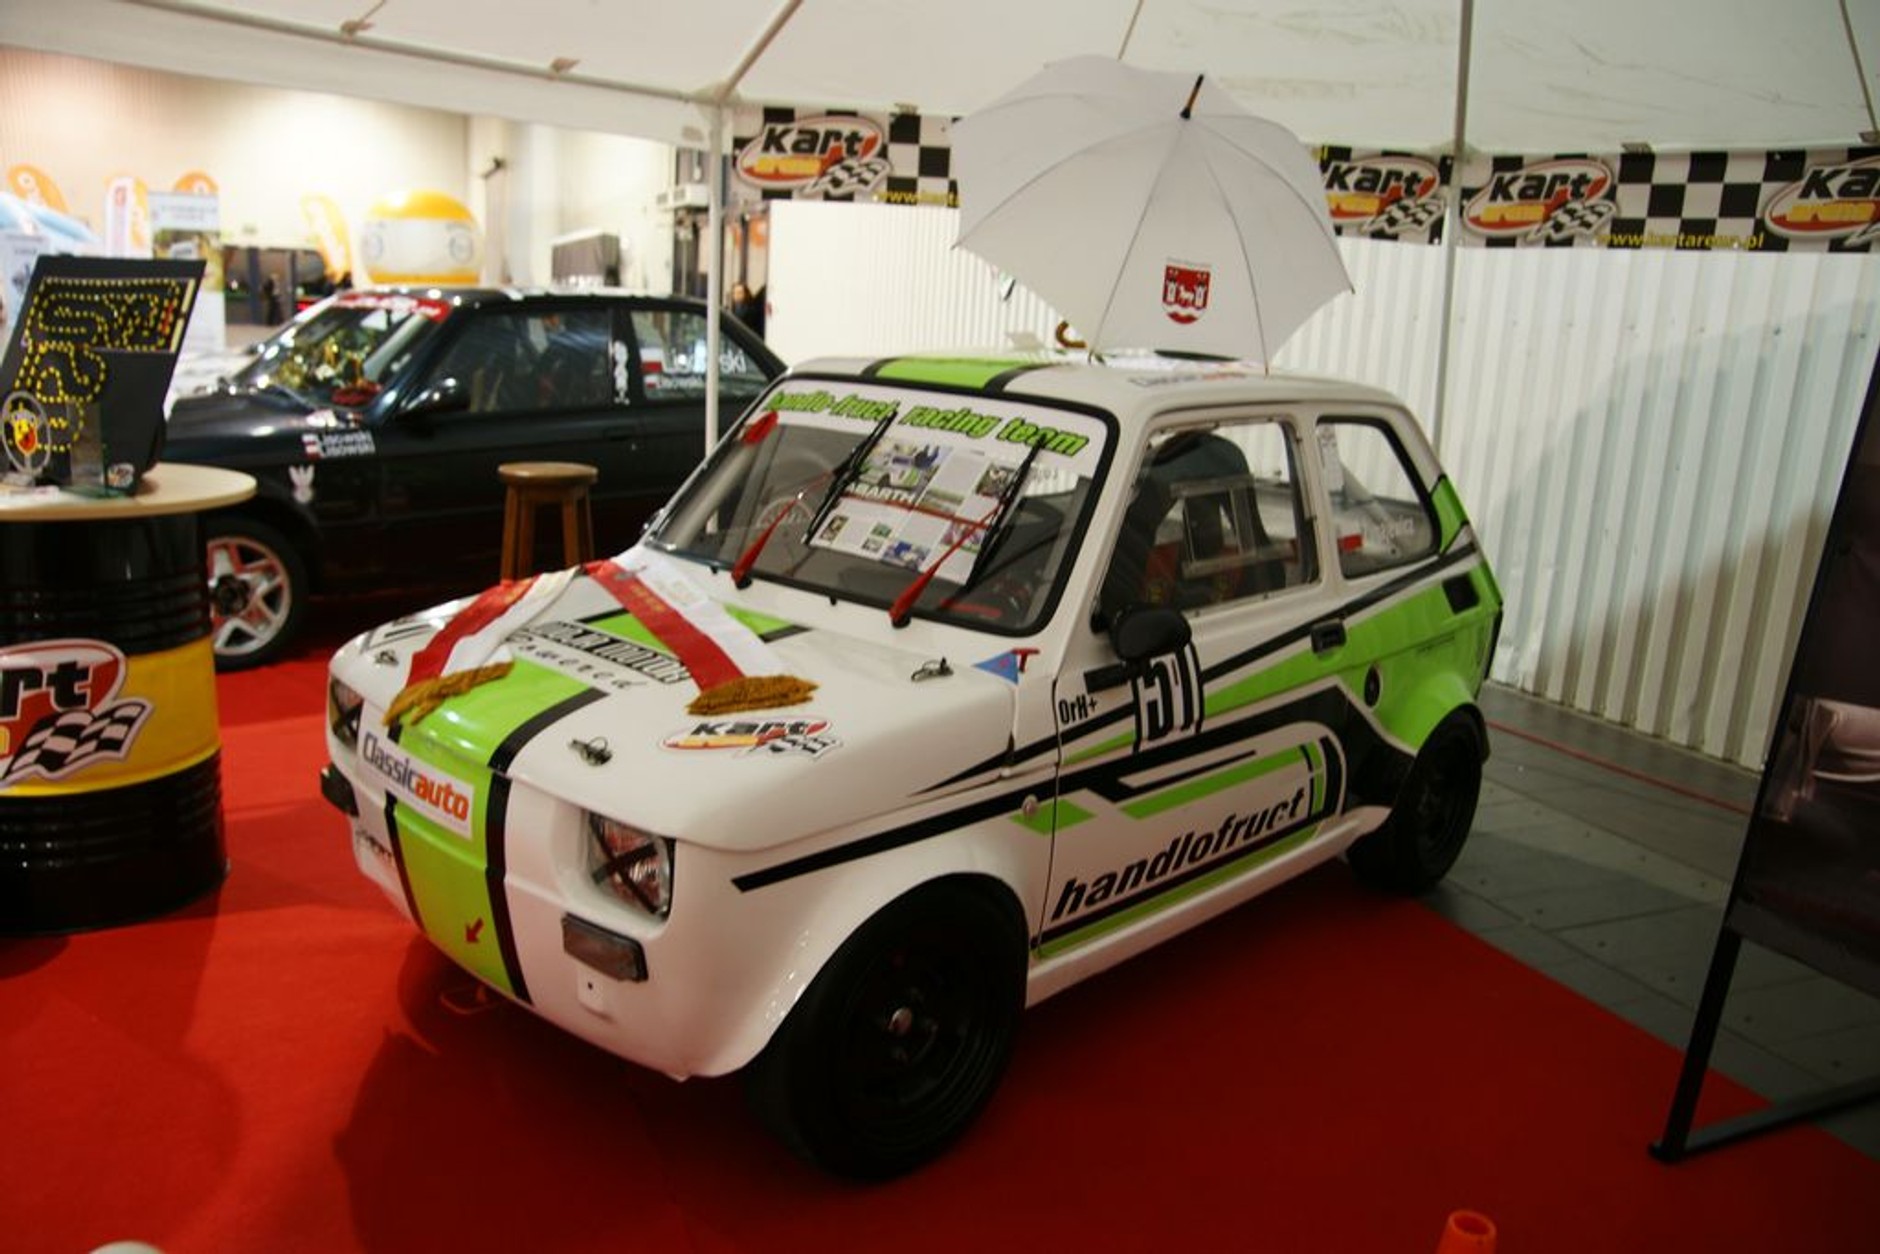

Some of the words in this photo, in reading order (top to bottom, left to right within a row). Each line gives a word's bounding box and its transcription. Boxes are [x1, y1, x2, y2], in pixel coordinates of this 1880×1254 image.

[761, 126, 863, 157] Kart
[1325, 164, 1421, 195] Kart
[1488, 172, 1592, 202] Kart
[899, 406, 1002, 439] racing
[996, 417, 1090, 457] team
[690, 721, 809, 737] Kart
[1051, 788, 1306, 922] handlofruct
